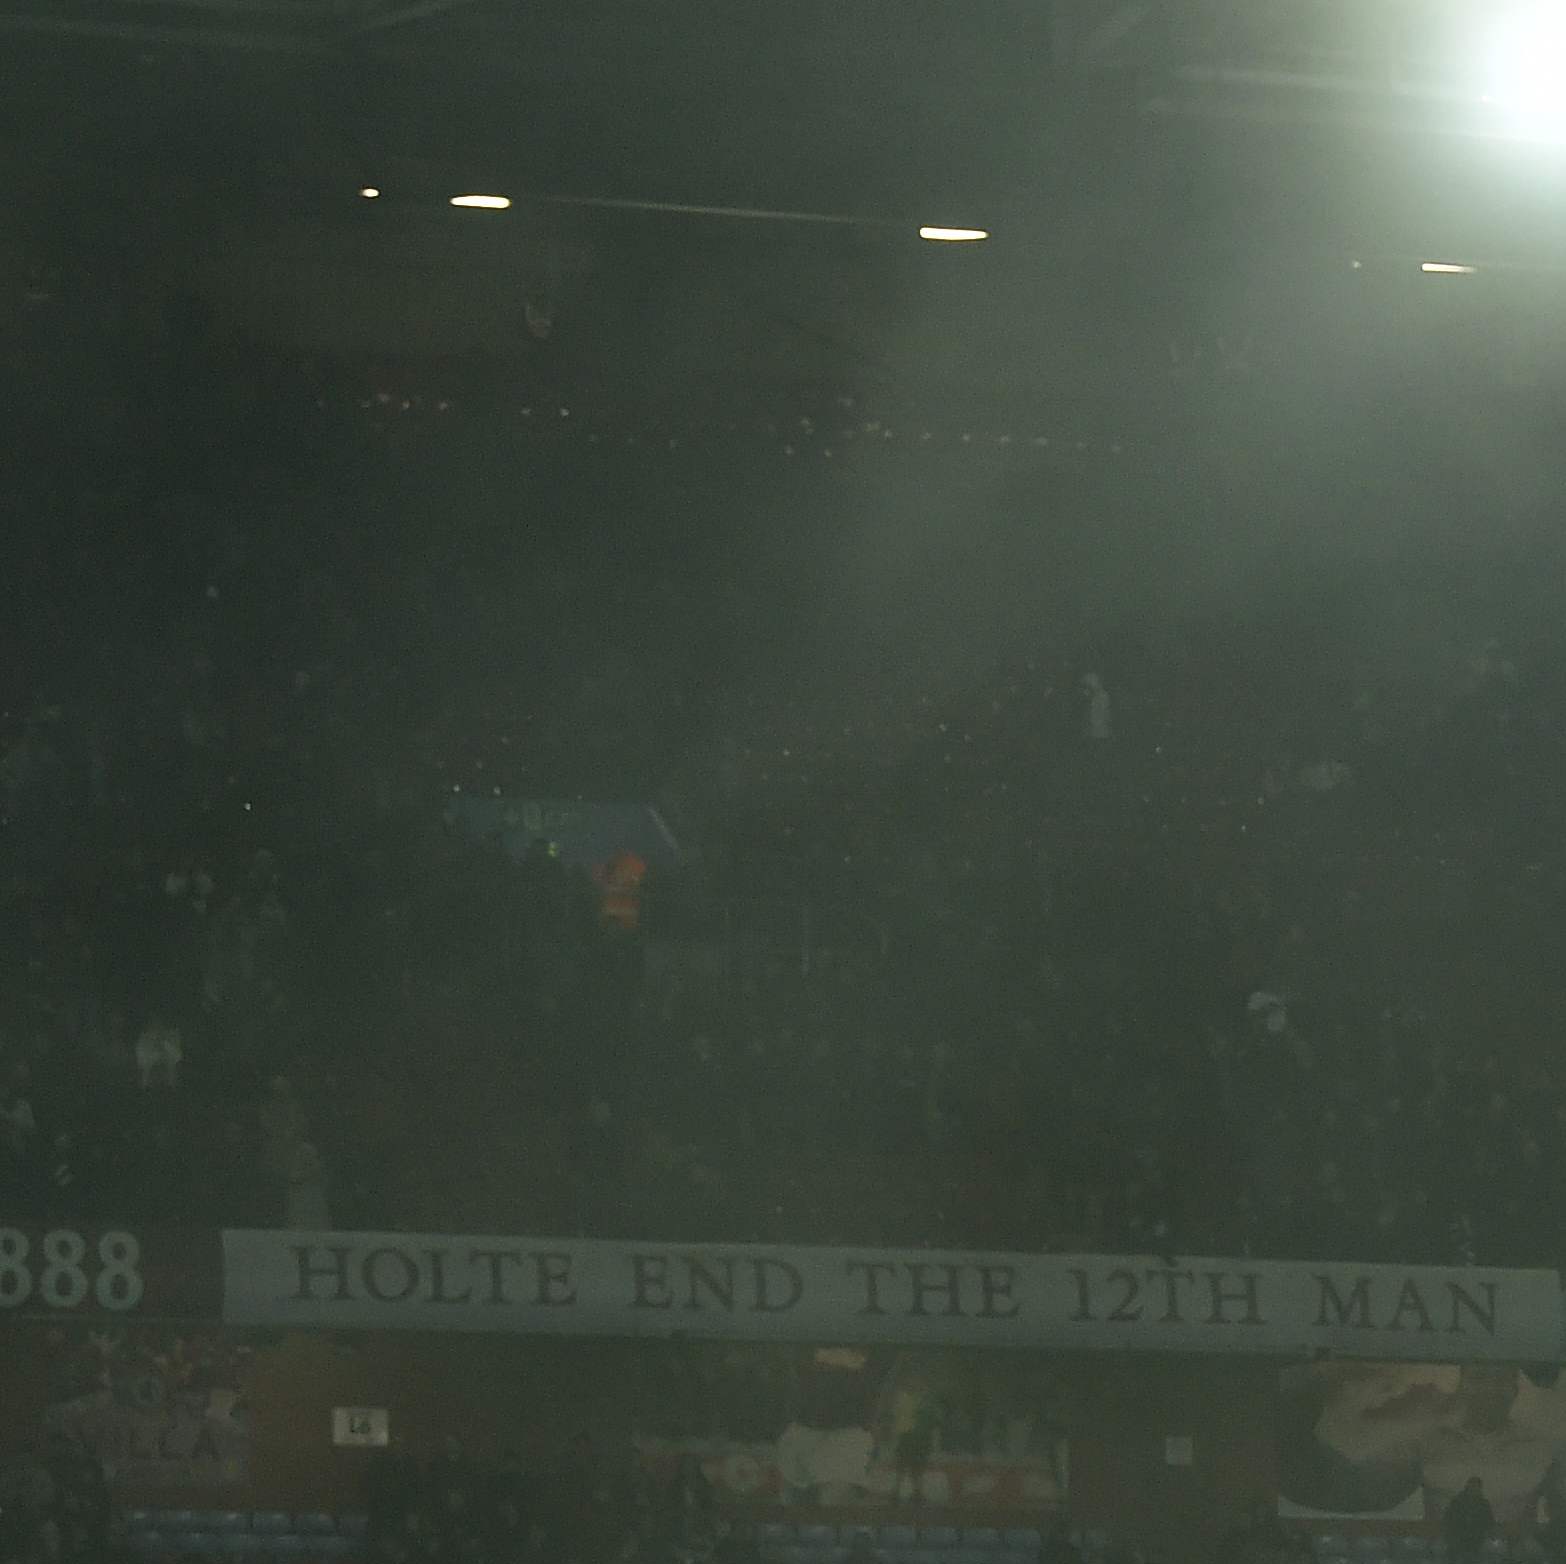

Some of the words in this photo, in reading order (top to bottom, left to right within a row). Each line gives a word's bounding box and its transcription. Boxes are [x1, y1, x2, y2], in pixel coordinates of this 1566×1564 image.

[289, 1244, 578, 1306] HOLTE
[631, 1254, 804, 1314] END
[847, 1260, 1022, 1318] THE
[1067, 1266, 1270, 1326] 12TH
[1312, 1275, 1501, 1337] MAN
